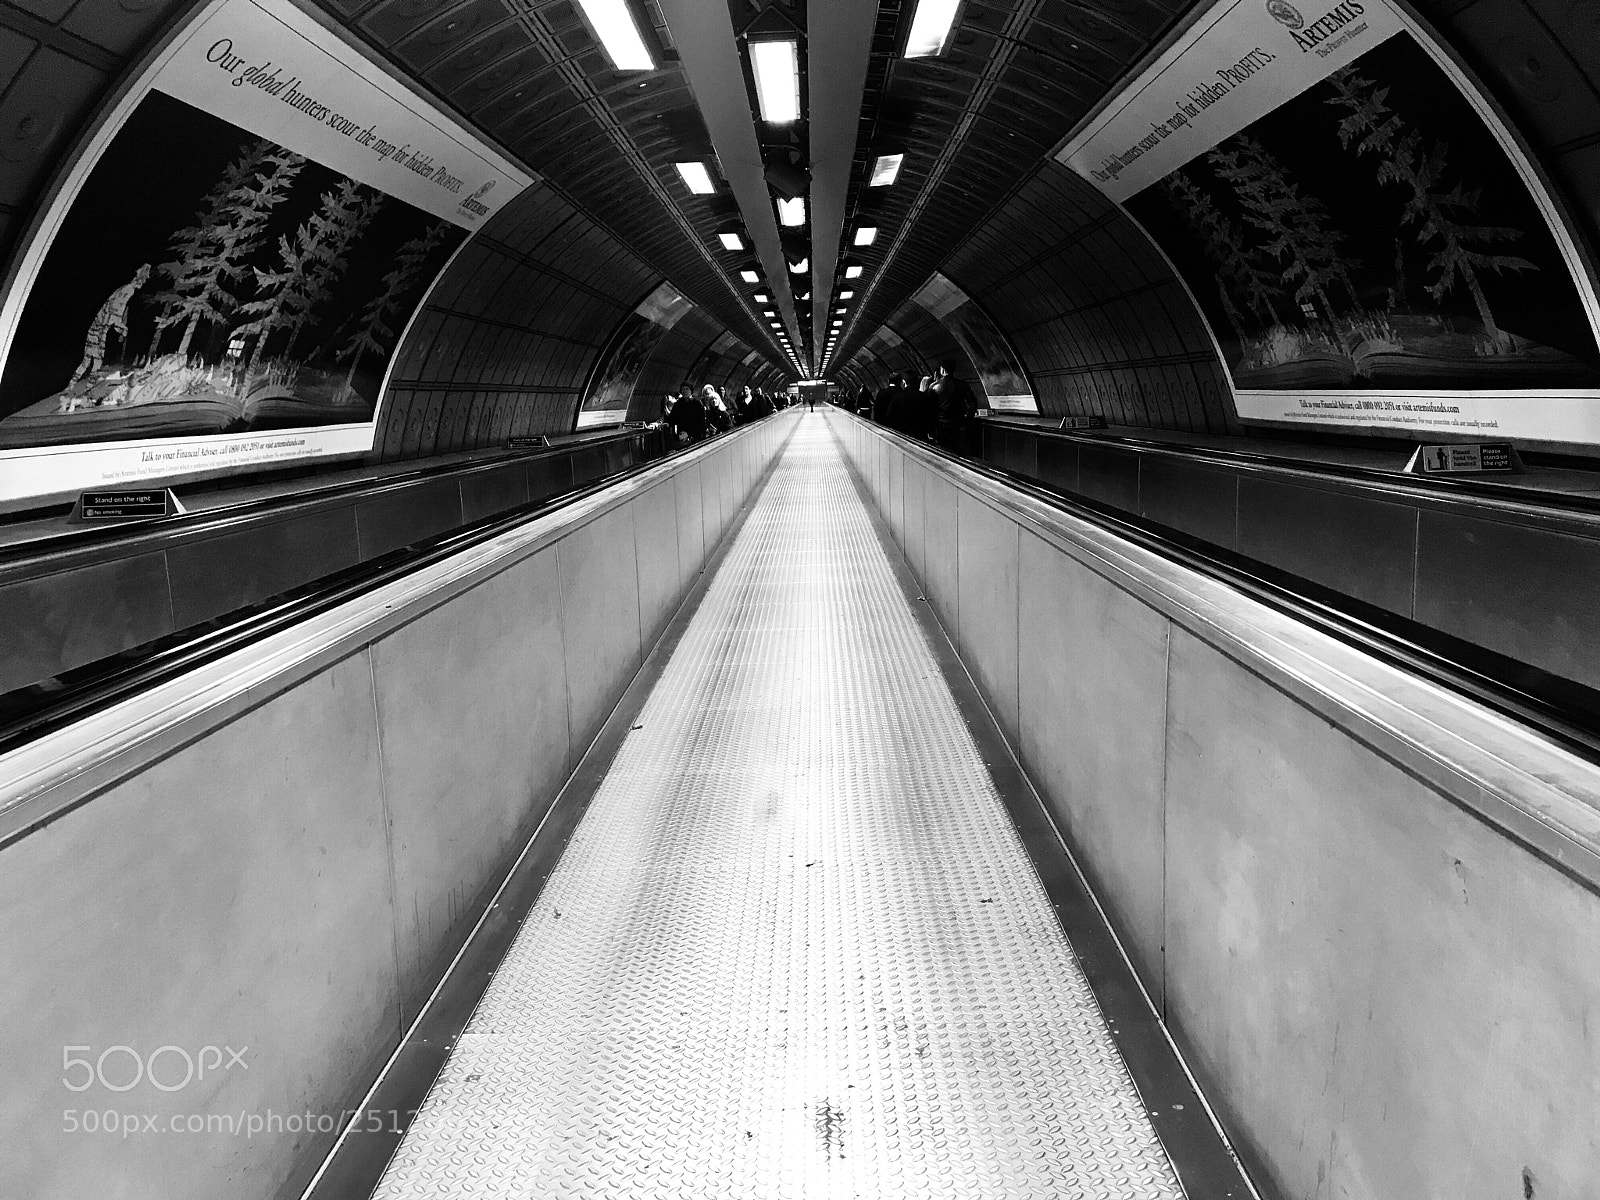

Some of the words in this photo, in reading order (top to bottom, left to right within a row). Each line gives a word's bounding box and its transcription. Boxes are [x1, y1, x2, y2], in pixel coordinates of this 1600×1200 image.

[1289, 0, 1364, 53] ARTEMIS
[1216, 47, 1276, 88] PROFITS.
[1186, 82, 1231, 110] hidden
[206, 38, 246, 73] Our
[231, 62, 282, 96] global
[280, 77, 331, 121] hunters
[325, 113, 361, 137] scour
[354, 125, 377, 147] the
[371, 138, 396, 161] map
[391, 144, 410, 164] for
[403, 151, 434, 178] hidden
[1176, 101, 1200, 118] for
[1166, 112, 1193, 129] map
[1150, 122, 1173, 139] the
[1138, 133, 1161, 152] scour
[1111, 145, 1144, 166] hunters
[1091, 170, 1110, 182] Our
[1101, 155, 1124, 180] global
[1401, 401, 1412, 411] visit
[142, 451, 154, 462] Talk
[162, 452, 175, 463] your
[176, 447, 200, 459] Financial
[94, 496, 113, 504] Stand
[136, 495, 151, 503] right
